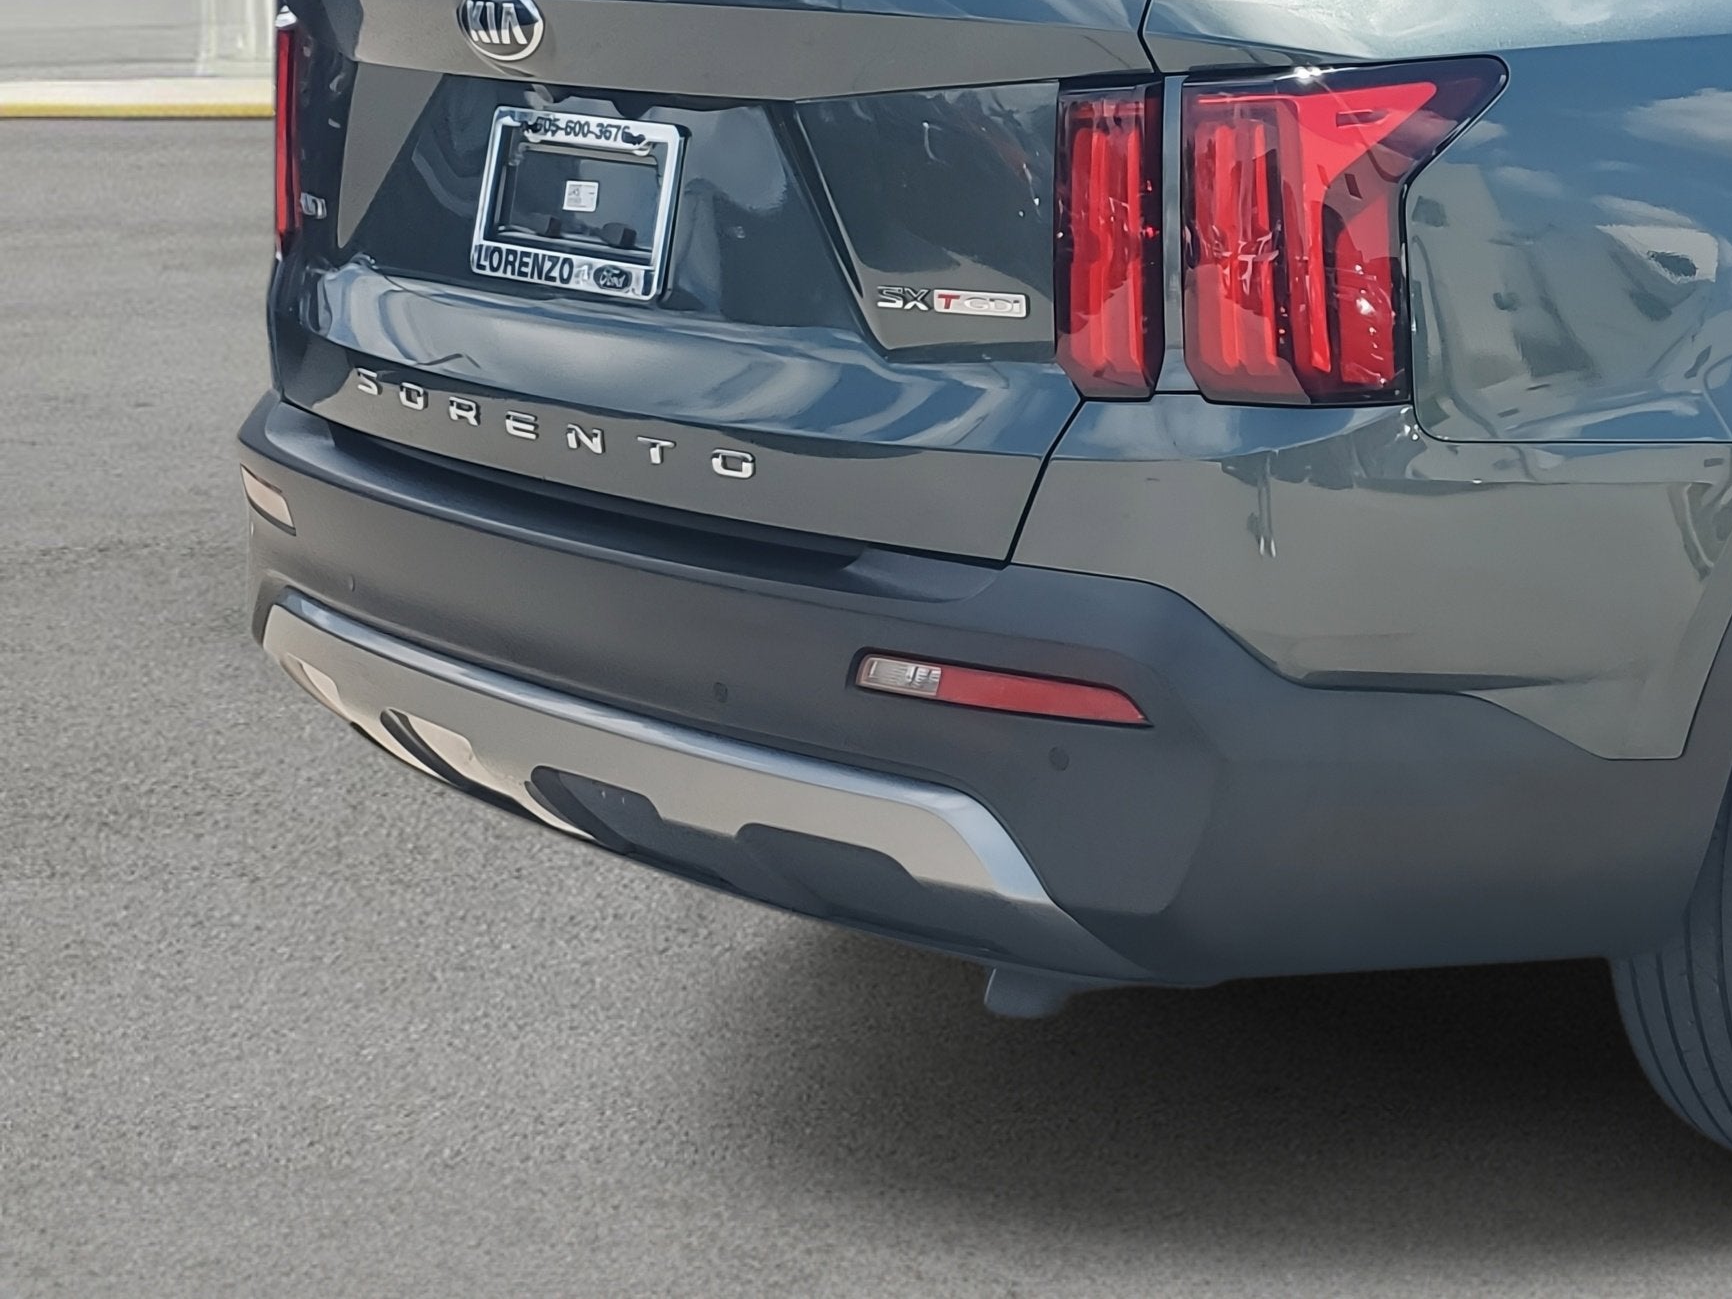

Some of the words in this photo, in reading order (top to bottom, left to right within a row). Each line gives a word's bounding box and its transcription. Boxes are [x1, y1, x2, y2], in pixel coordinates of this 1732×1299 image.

[466, 0, 529, 45] KIA
[475, 244, 575, 285] LORENZO
[877, 285, 931, 311] SX
[356, 367, 757, 480] SORENTO
